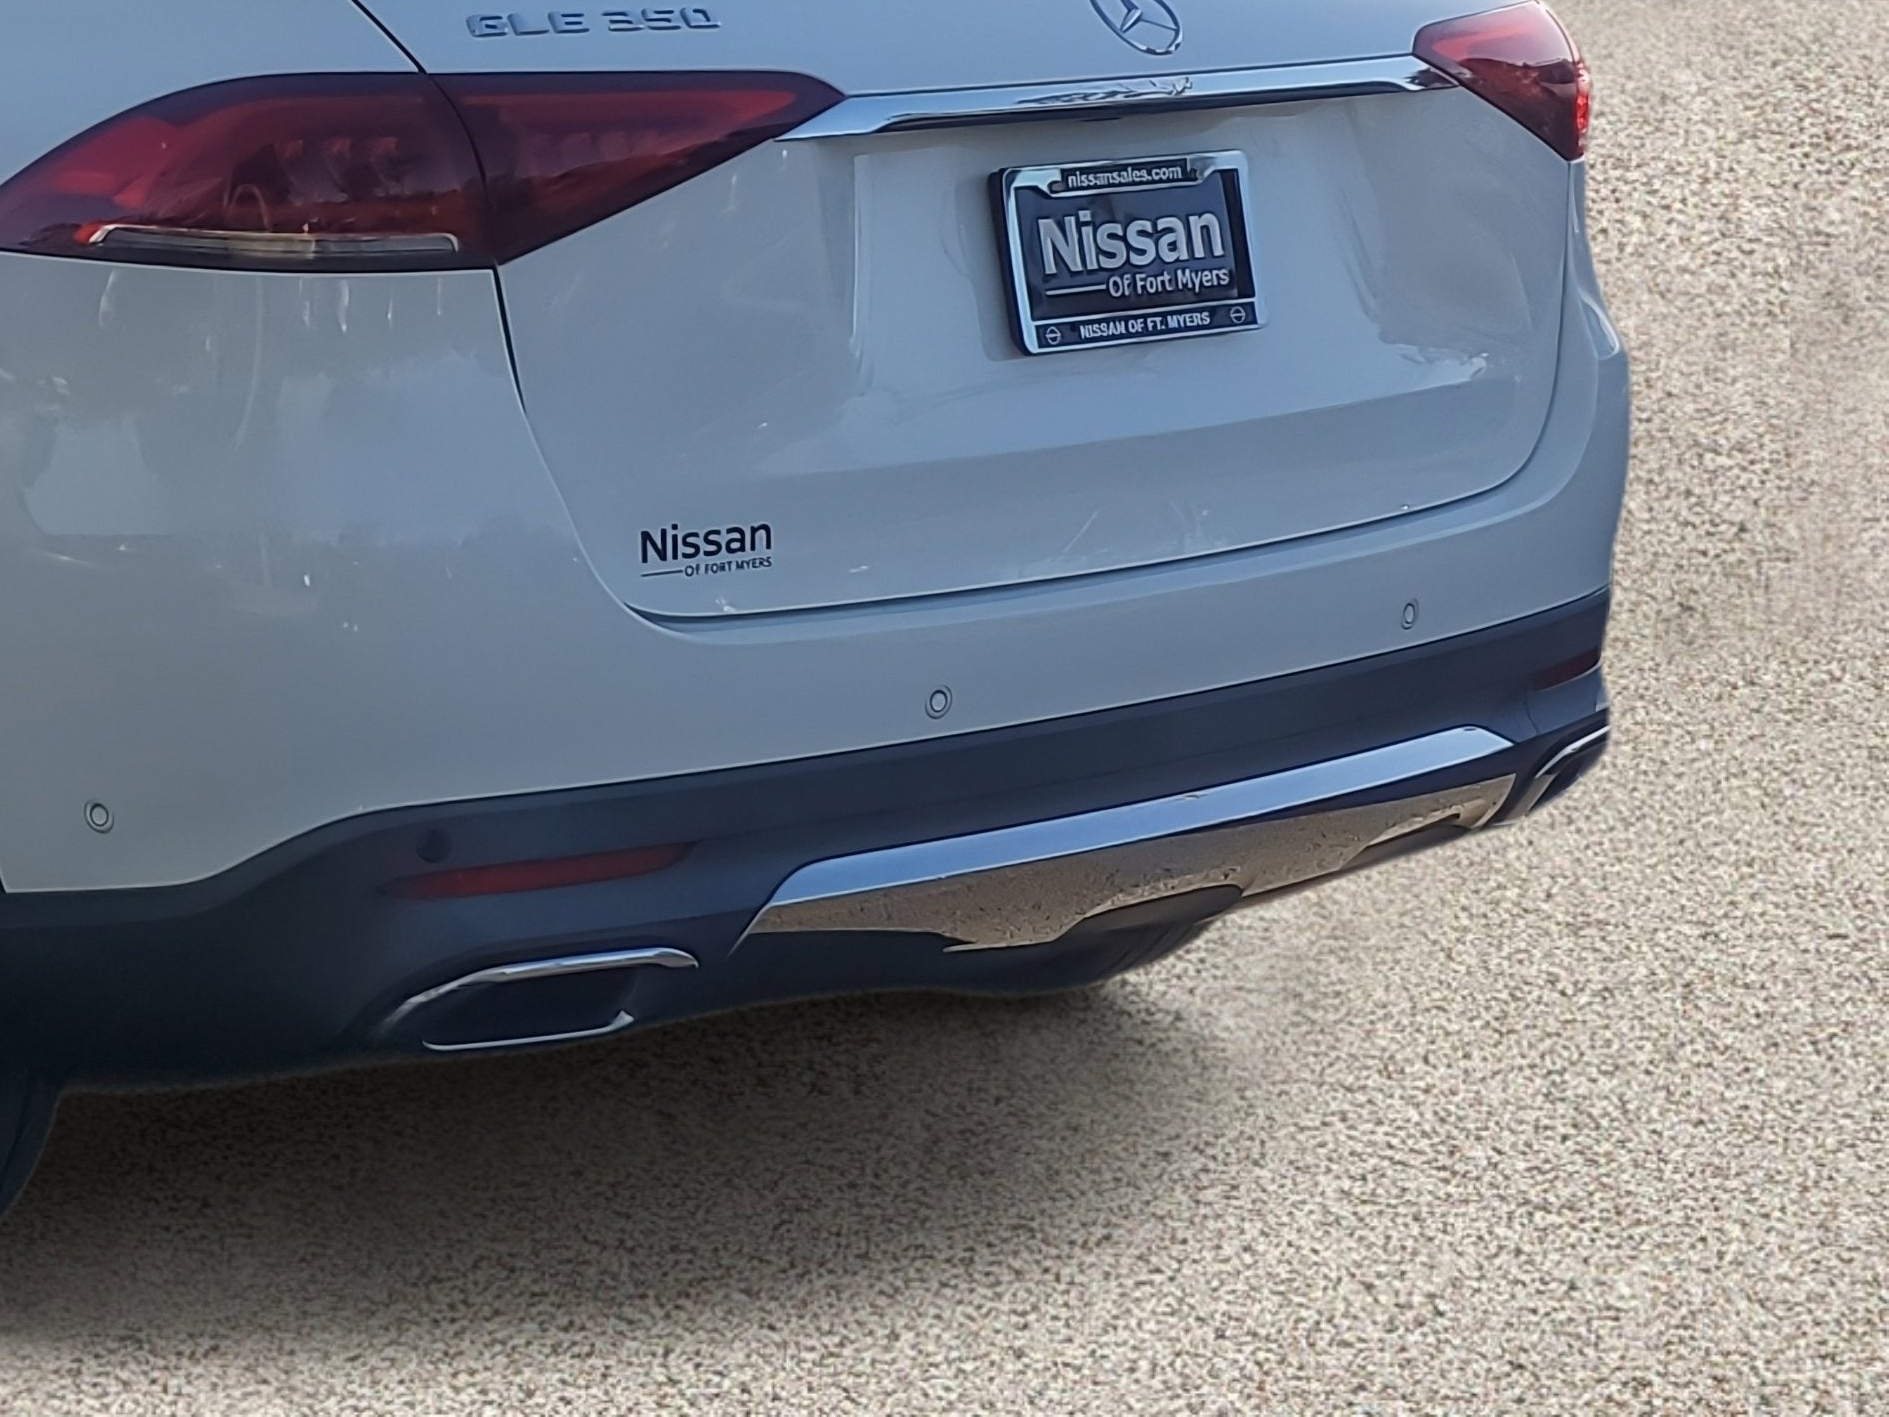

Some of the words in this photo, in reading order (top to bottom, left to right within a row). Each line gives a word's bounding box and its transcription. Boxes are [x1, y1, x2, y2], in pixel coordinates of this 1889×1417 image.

[466, 11, 590, 38] GLE
[602, 7, 722, 32] 350
[1067, 166, 1182, 189] nissansales.com
[1037, 209, 1225, 275] Nissan
[1136, 272, 1173, 295] Fort
[1177, 268, 1229, 293] Myers
[1079, 322, 1126, 340] NISSAN
[1129, 319, 1145, 335] OF
[1168, 311, 1211, 331] MYERS
[640, 523, 772, 564] Nissan
[704, 560, 733, 575] FORT
[735, 556, 772, 569] MYERS
